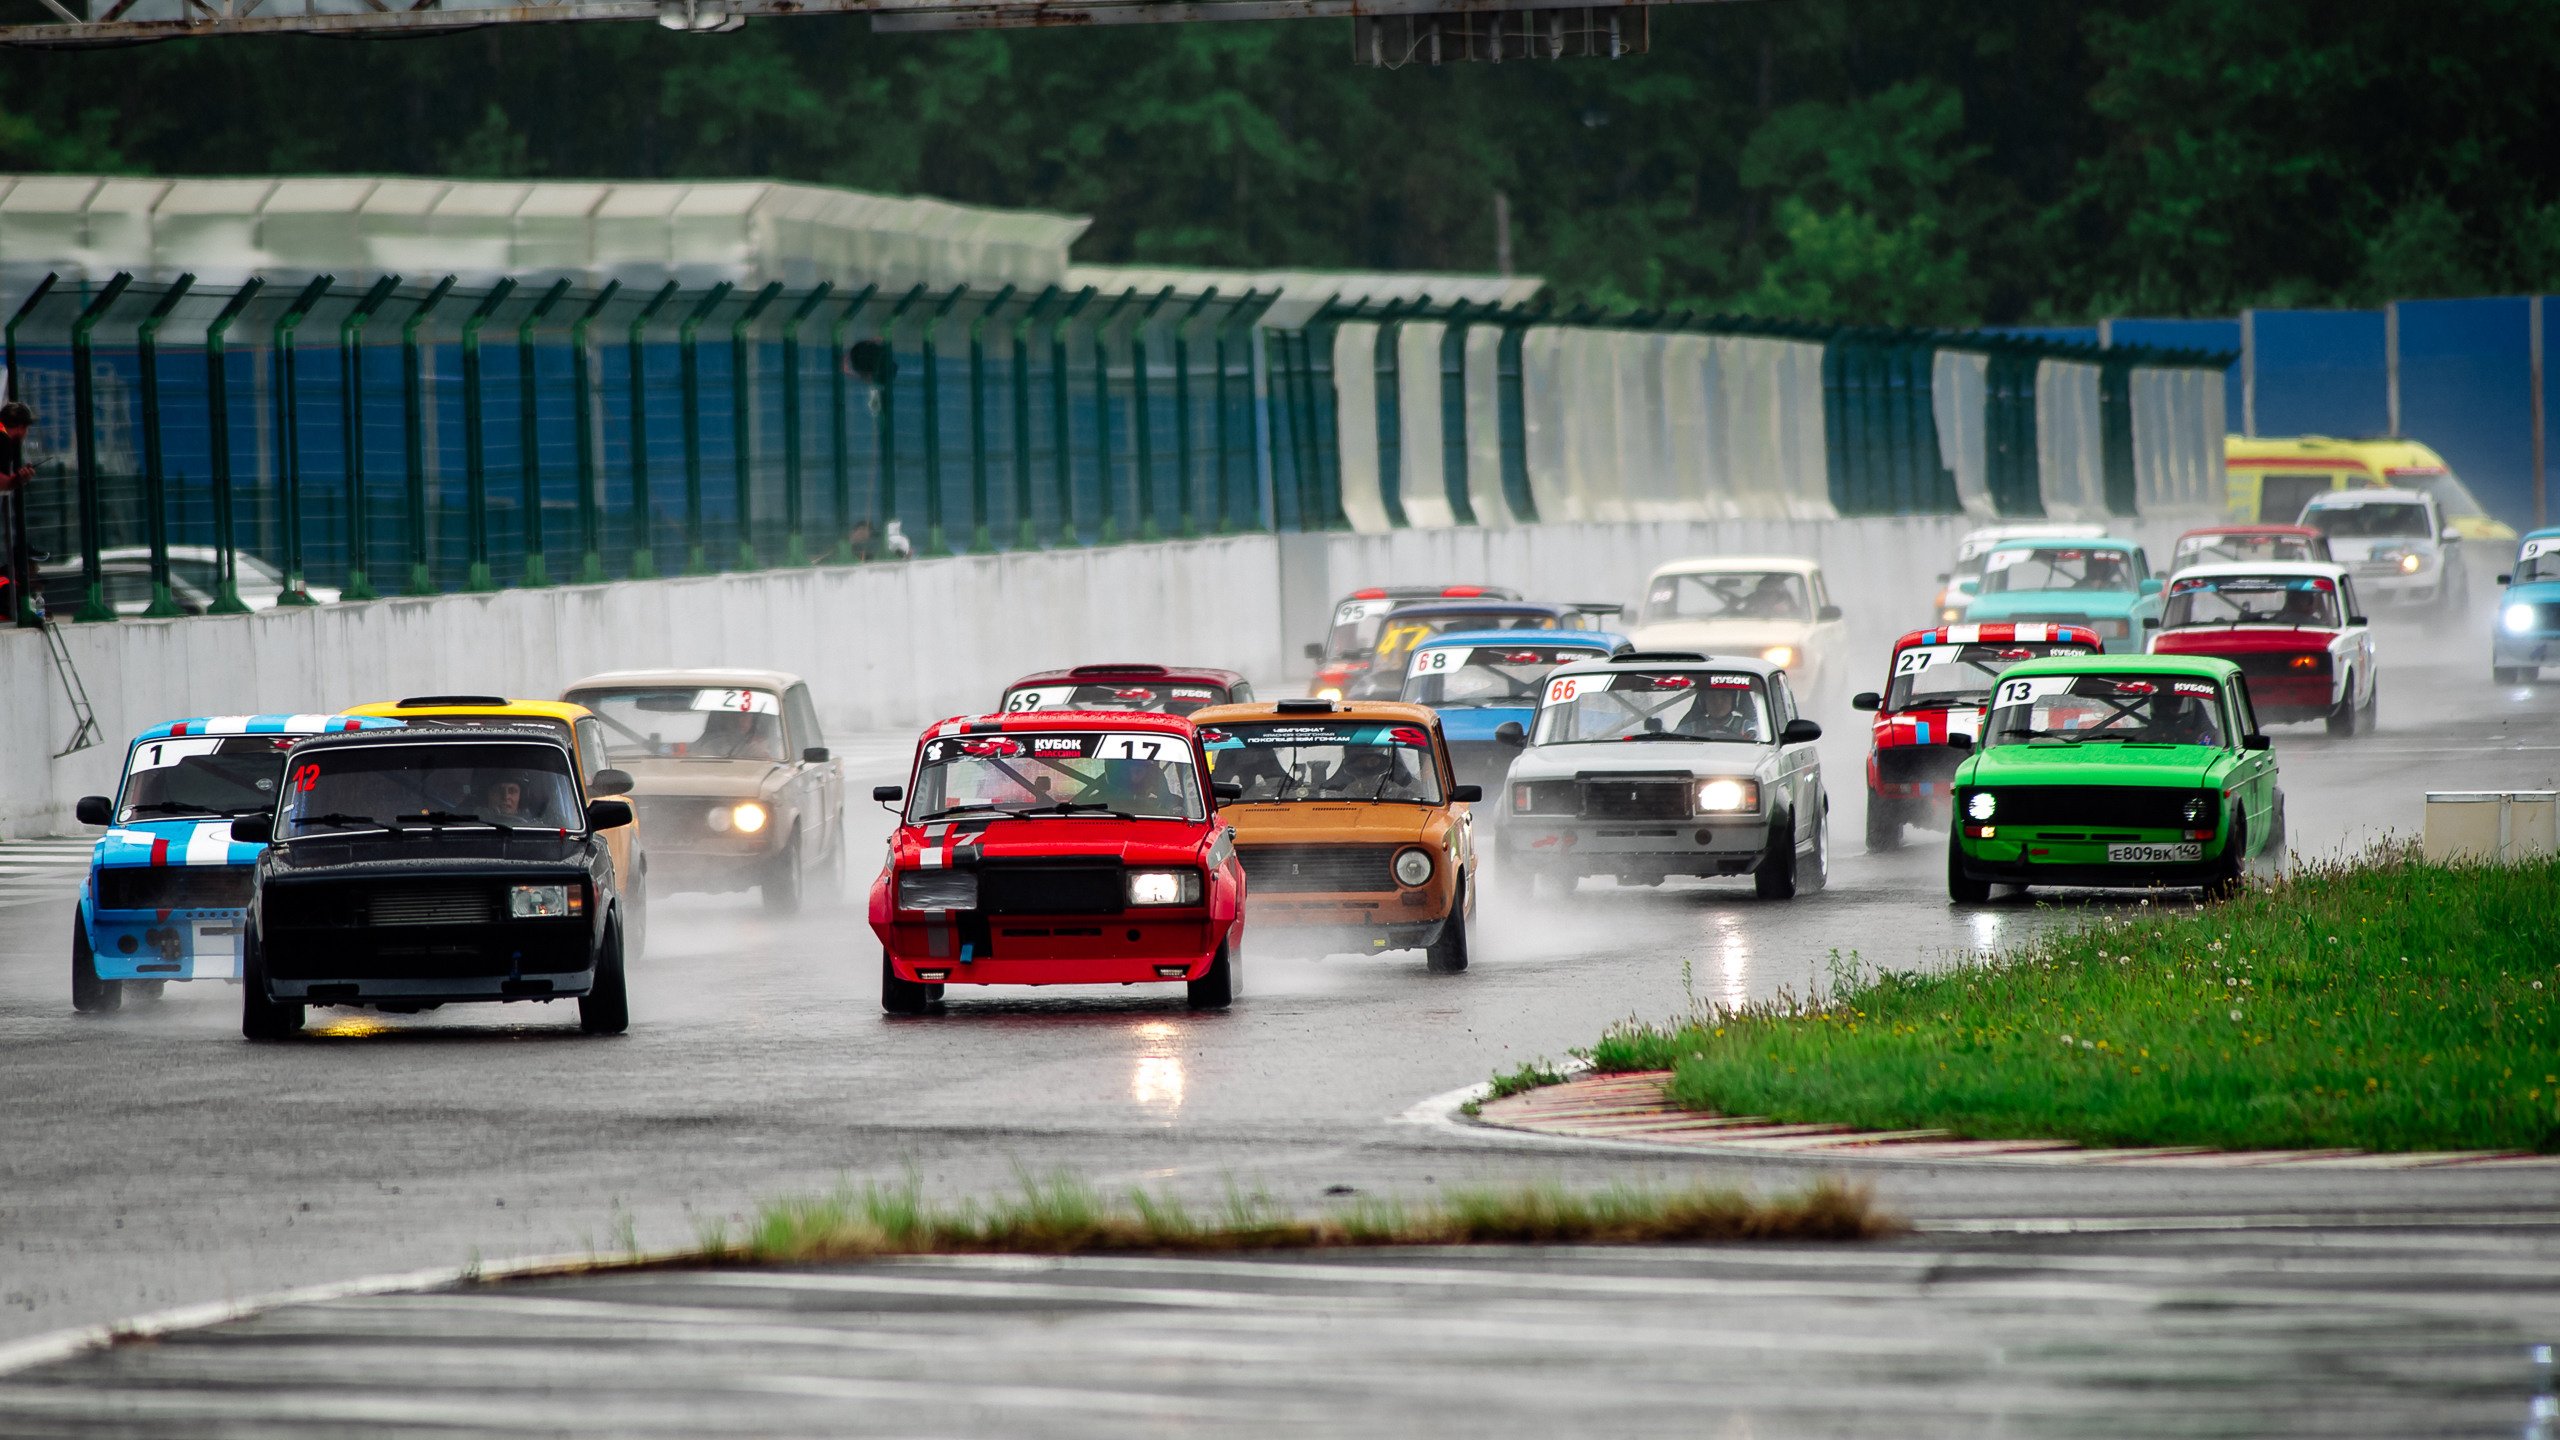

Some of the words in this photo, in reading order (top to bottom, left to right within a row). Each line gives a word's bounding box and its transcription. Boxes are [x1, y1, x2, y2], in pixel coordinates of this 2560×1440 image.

[2528, 543, 2538, 556] 9
[1341, 605, 1364, 621] 95
[1376, 625, 1431, 655] 47
[1418, 652, 1447, 672] 68
[1899, 652, 1932, 672] 27
[1710, 675, 1750, 686] КУБОК
[2174, 682, 2215, 695] КУБОК
[1171, 689, 1212, 699] КУБОК
[1551, 680, 1576, 701] 66
[2005, 682, 2032, 701] 13
[722, 690, 752, 712] 23
[1008, 693, 1041, 713] 69
[1034, 738, 1081, 751] КУБОК
[1120, 740, 1162, 760] 17
[149, 744, 163, 766] 1
[1034, 750, 1081, 759] КЛАССИКИ
[292, 764, 321, 793] 12
[2111, 846, 2173, 861] Е809ВК
[2175, 844, 2200, 856] 142
